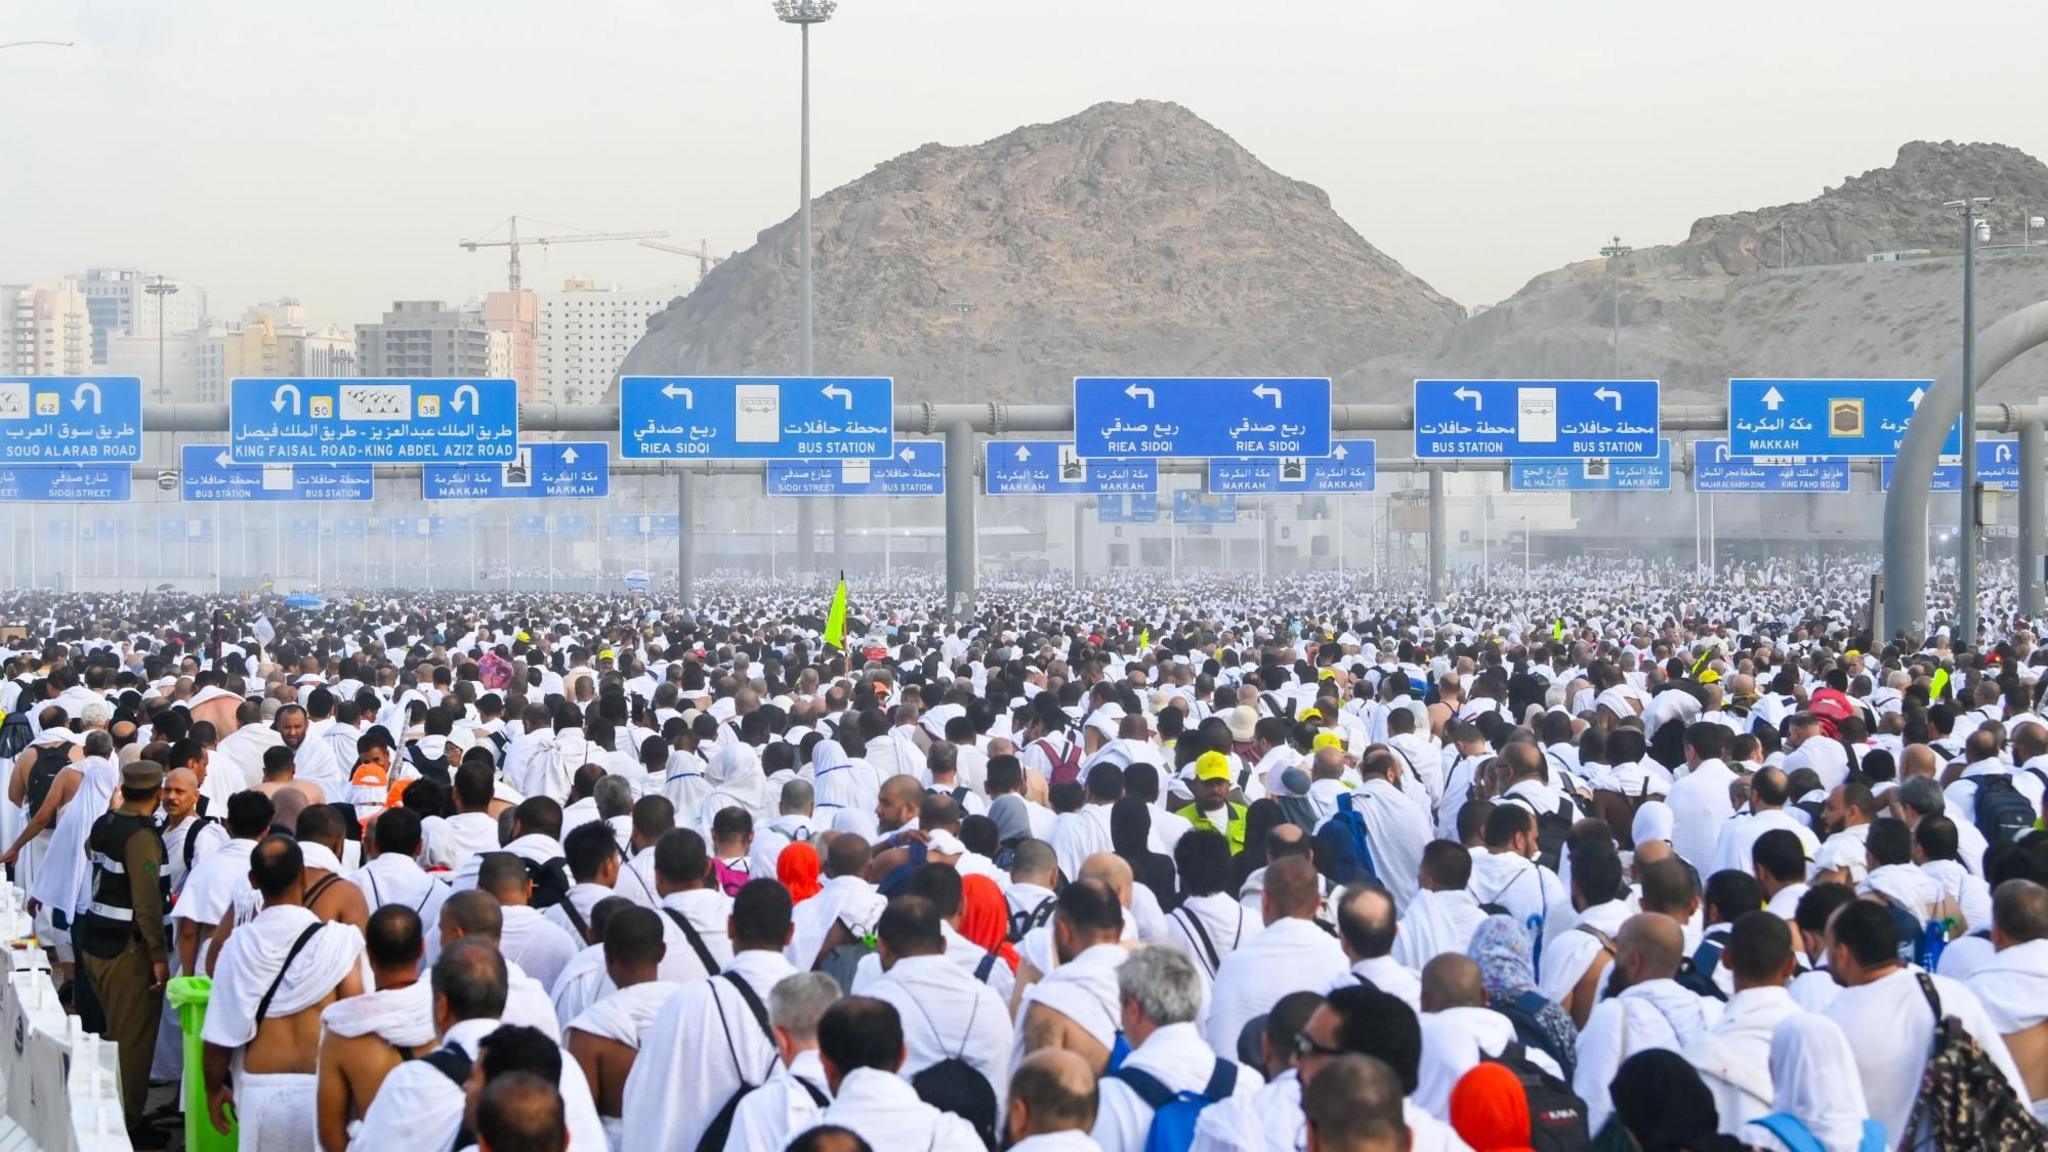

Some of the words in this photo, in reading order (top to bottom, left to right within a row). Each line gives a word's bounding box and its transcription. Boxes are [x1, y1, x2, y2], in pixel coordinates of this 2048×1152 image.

[41, 404, 55, 412] 62
[314, 406, 328, 416] 50
[423, 406, 436, 414] 38
[280, 424, 318, 436] الملك
[438, 424, 474, 436] الملك
[634, 419, 684, 441] صدقي
[784, 420, 841, 434] حافلات
[845, 422, 888, 434] محطة
[1101, 418, 1148, 439] صدقي
[1229, 418, 1276, 438] صدقي
[1420, 420, 1472, 434] حافلات
[1476, 421, 1515, 434] محطة
[1561, 420, 1613, 434] حافلات
[1616, 421, 1655, 434] محطة
[1736, 418, 1784, 432] المكرمة
[1788, 418, 1812, 430] مكة
[6, 424, 52, 440] العرب
[58, 423, 92, 439] سوق
[96, 423, 135, 440] طريق
[236, 422, 278, 440] فيصل
[320, 424, 356, 441] طريق
[476, 424, 512, 440] طريق
[690, 425, 716, 440] ريع
[1153, 424, 1179, 438] ريع
[1281, 423, 1306, 438] ريع
[6, 444, 40, 457] SOUQ
[104, 444, 136, 456] ROAD
[236, 444, 264, 457] KING
[269, 444, 317, 457] FAISAL
[398, 444, 439, 456] ABDEL
[444, 444, 474, 456] AZIZ
[478, 444, 512, 456] ROAD
[641, 443, 671, 453] RIEA
[676, 443, 710, 454] SIDQI
[799, 442, 822, 453] BUS
[826, 442, 876, 454] STATION
[1108, 442, 1136, 452] RIEA
[1141, 442, 1172, 452] SIDQI
[1236, 442, 1264, 452] RIEA
[1268, 441, 1300, 452] SIDQI
[1432, 442, 1454, 452] BUS
[1458, 442, 1502, 452] STATION
[1573, 442, 1595, 452] BUS
[1598, 442, 1642, 452] STATION
[1750, 440, 1799, 449] MAKKAH
[581, 472, 598, 482] مكة
[874, 467, 910, 478] حافلات
[912, 466, 940, 478] محطة
[996, 470, 1030, 482] المكرمة
[1033, 470, 1049, 480] مكة
[1096, 468, 1128, 480] المكرمة
[1132, 468, 1148, 480] مكة
[1218, 468, 1250, 480] المكرمة
[1254, 467, 1270, 478] مكة
[1314, 466, 1346, 480] المكرمة
[1350, 466, 1366, 477] مكة
[1615, 466, 1646, 478] المكرمة
[1648, 466, 1664, 476] مكة
[186, 474, 227, 485] حافلات
[230, 475, 260, 485] محطة
[296, 474, 337, 484] حافلات
[340, 474, 370, 484] محطة
[434, 473, 470, 486] المكرمة
[474, 473, 492, 482] مكة
[542, 472, 577, 484] المكرمة
[1618, 479, 1660, 487] MAKKAH
[546, 486, 594, 494] MAKKAH
[1000, 483, 1045, 492] MAKKAH
[1100, 482, 1144, 491] MAKKAH
[1222, 482, 1266, 490] MAKKAH
[1319, 481, 1362, 489] MAKKAH
[1820, 481, 1840, 489] ROAD
[76, 488, 112, 497] STREET
[196, 490, 213, 498] BUS
[216, 490, 250, 498] STATION
[306, 489, 323, 498] BUS
[326, 489, 360, 498] STATION
[439, 488, 488, 496] MAKKAH
